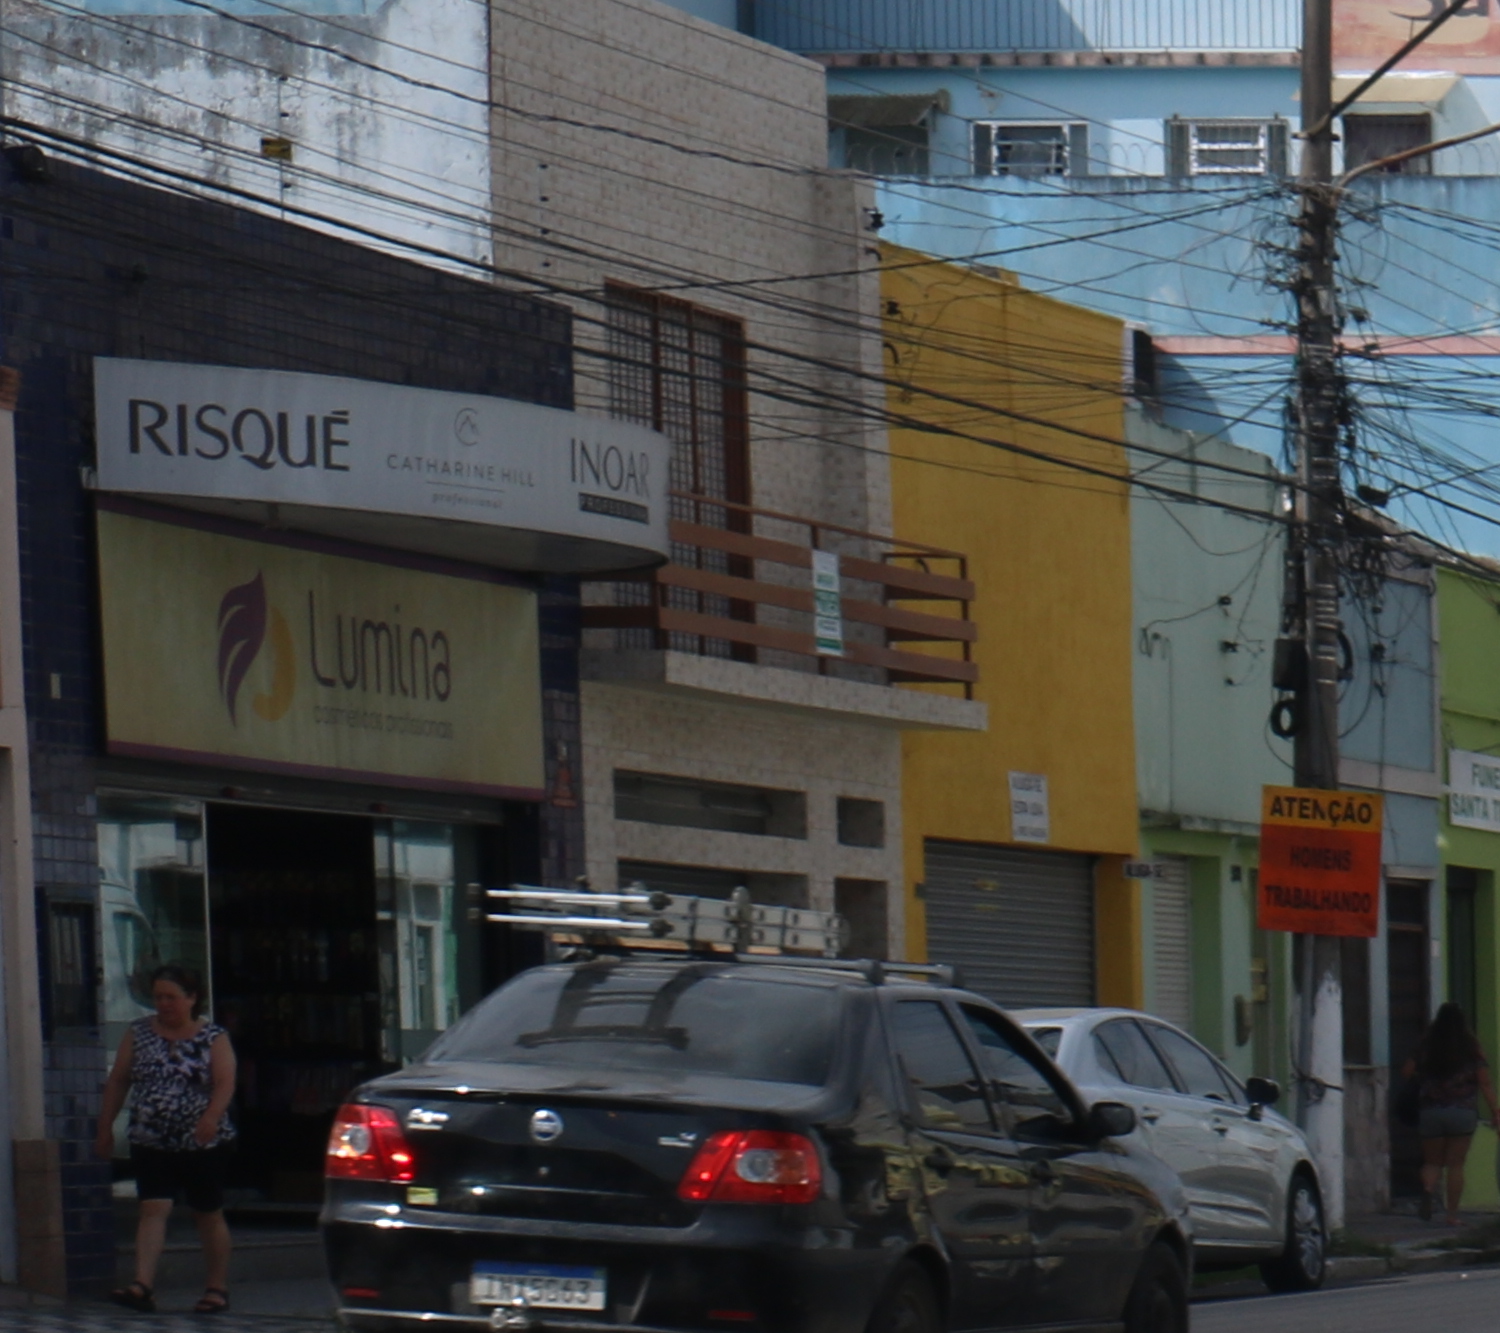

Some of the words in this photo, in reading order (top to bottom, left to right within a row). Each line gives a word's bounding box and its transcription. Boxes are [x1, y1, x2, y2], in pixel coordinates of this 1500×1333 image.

[128, 399, 350, 471] RISQUÉ
[387, 454, 495, 482] CATHARINE
[501, 467, 535, 488] HILL
[571, 437, 649, 498] INOAR
[309, 589, 452, 702] Lumina
[1270, 795, 1373, 828] ATENÇÃO
[1452, 793, 1489, 820] SANTA
[1290, 846, 1352, 873] HOMENS
[1264, 885, 1372, 914] TRABALHANDO
